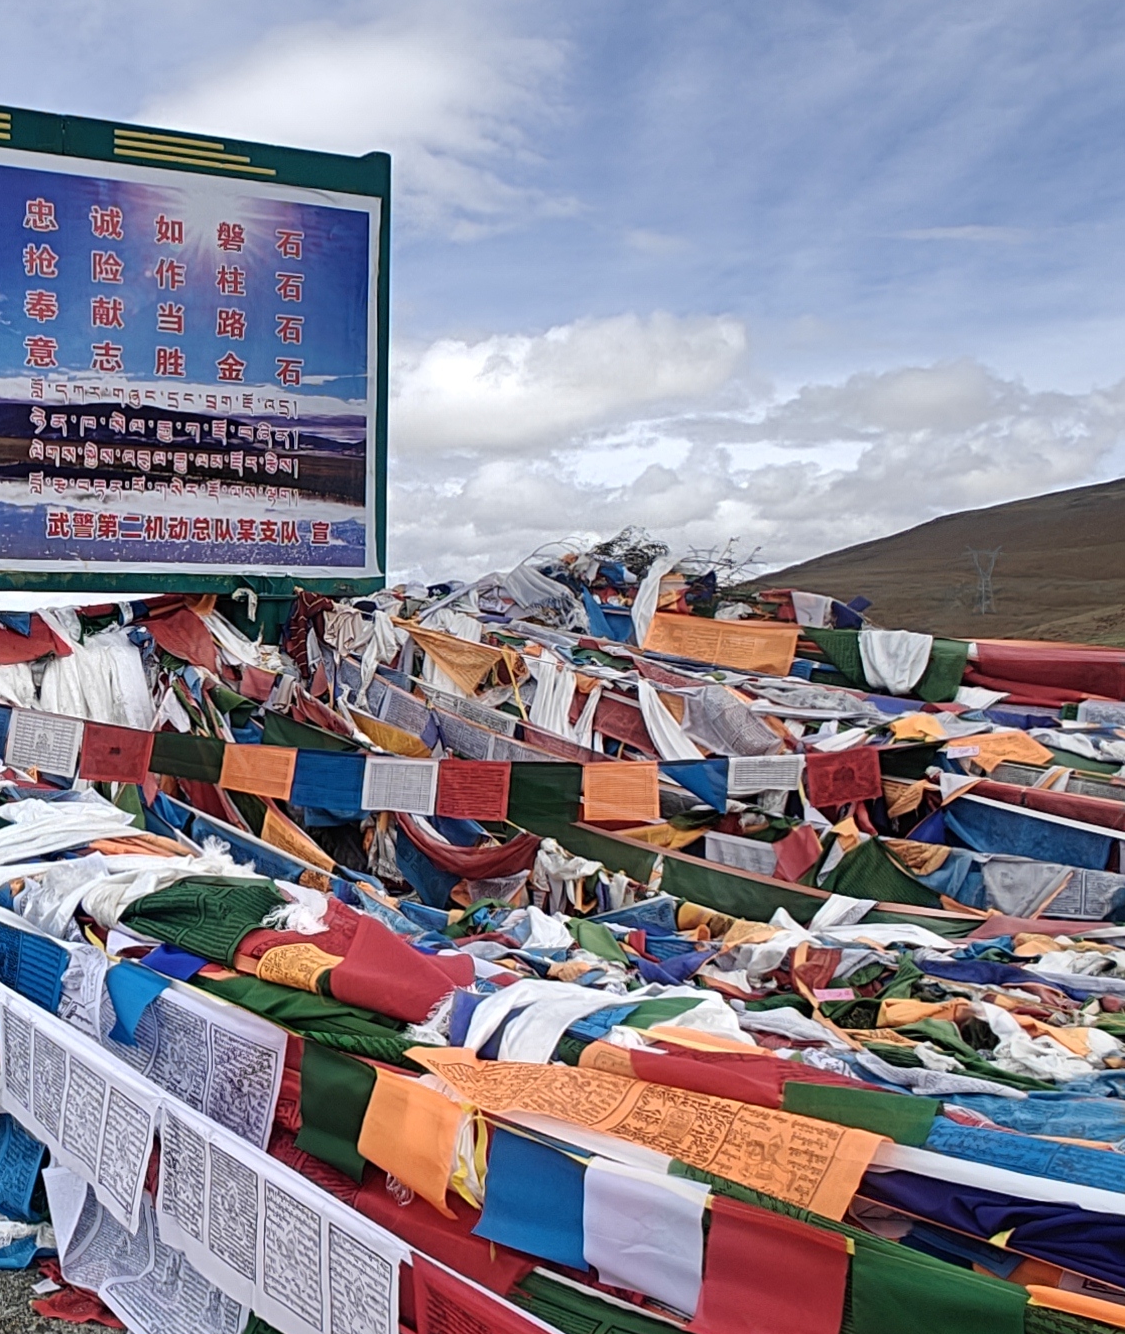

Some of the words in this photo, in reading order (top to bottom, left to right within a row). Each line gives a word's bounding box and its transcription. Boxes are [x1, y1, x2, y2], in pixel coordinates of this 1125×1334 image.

[24, 198, 304, 259] 忠诚如磐石
[23, 244, 304, 302] 抢险作柱石
[24, 289, 304, 345] 奉献当路石
[24, 334, 304, 387] 意志胜金石
